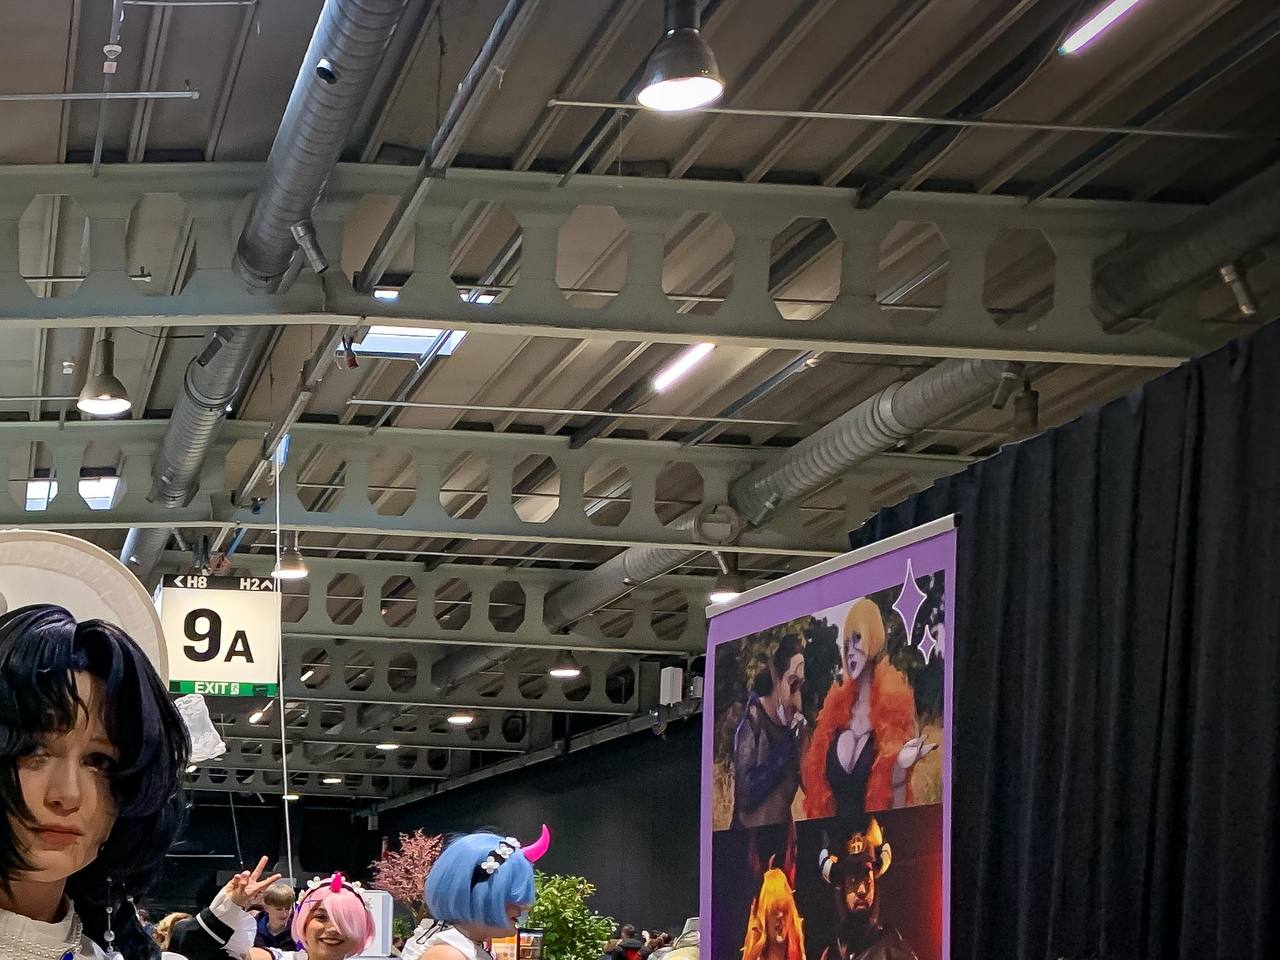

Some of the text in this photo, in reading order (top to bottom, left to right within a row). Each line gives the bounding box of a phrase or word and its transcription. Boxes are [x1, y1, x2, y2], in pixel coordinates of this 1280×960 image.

[187, 576, 207, 588] H8
[239, 578, 260, 590] H2
[194, 682, 229, 694] EXIT
